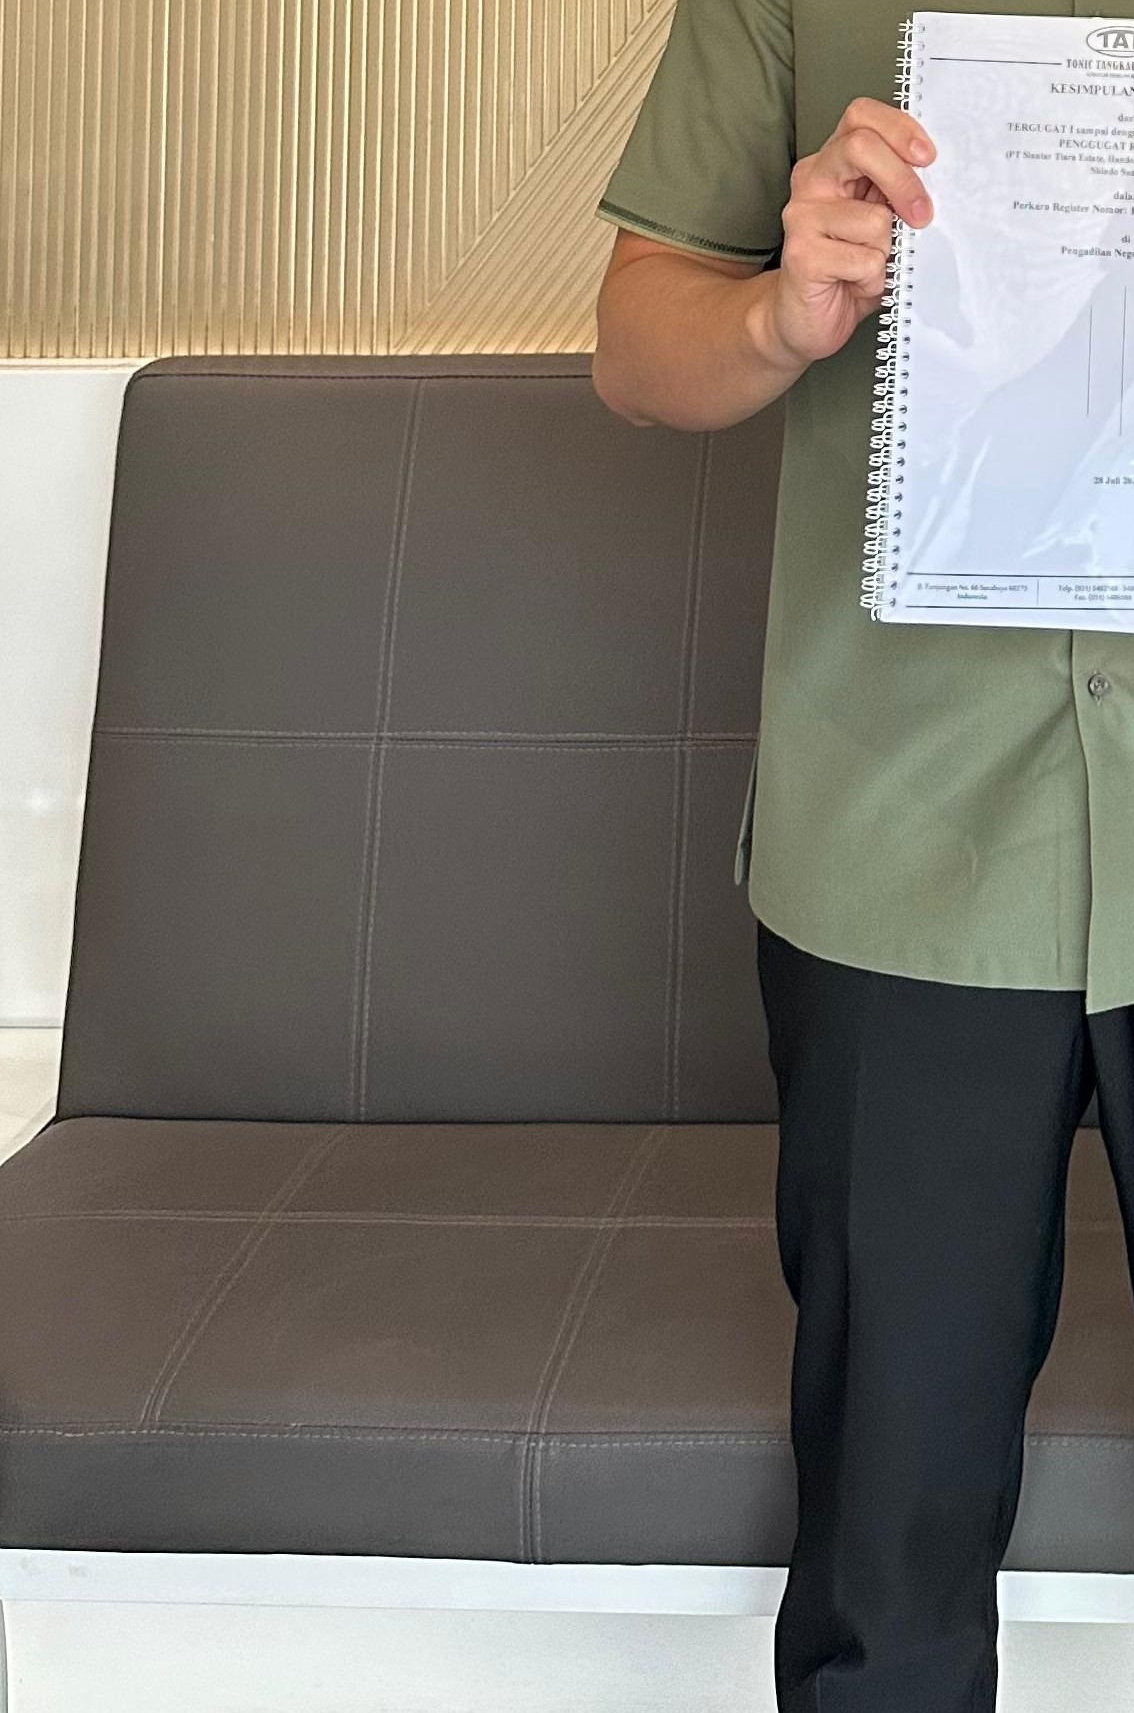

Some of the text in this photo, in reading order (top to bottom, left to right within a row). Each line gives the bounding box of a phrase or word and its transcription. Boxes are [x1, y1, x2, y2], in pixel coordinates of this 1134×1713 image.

[1066, 58, 1093, 69] TONIC
[1007, 122, 1067, 134] TERGUGAT
[1076, 125, 1108, 137] sampai
[1058, 138, 1127, 151] PENGGUGAT
[1012, 200, 1050, 211] Perkara
[1053, 202, 1089, 214] Register
[1121, 235, 1131, 244] di
[1060, 246, 1111, 258] Pengadilan
[1105, 476, 1121, 485] Juli
